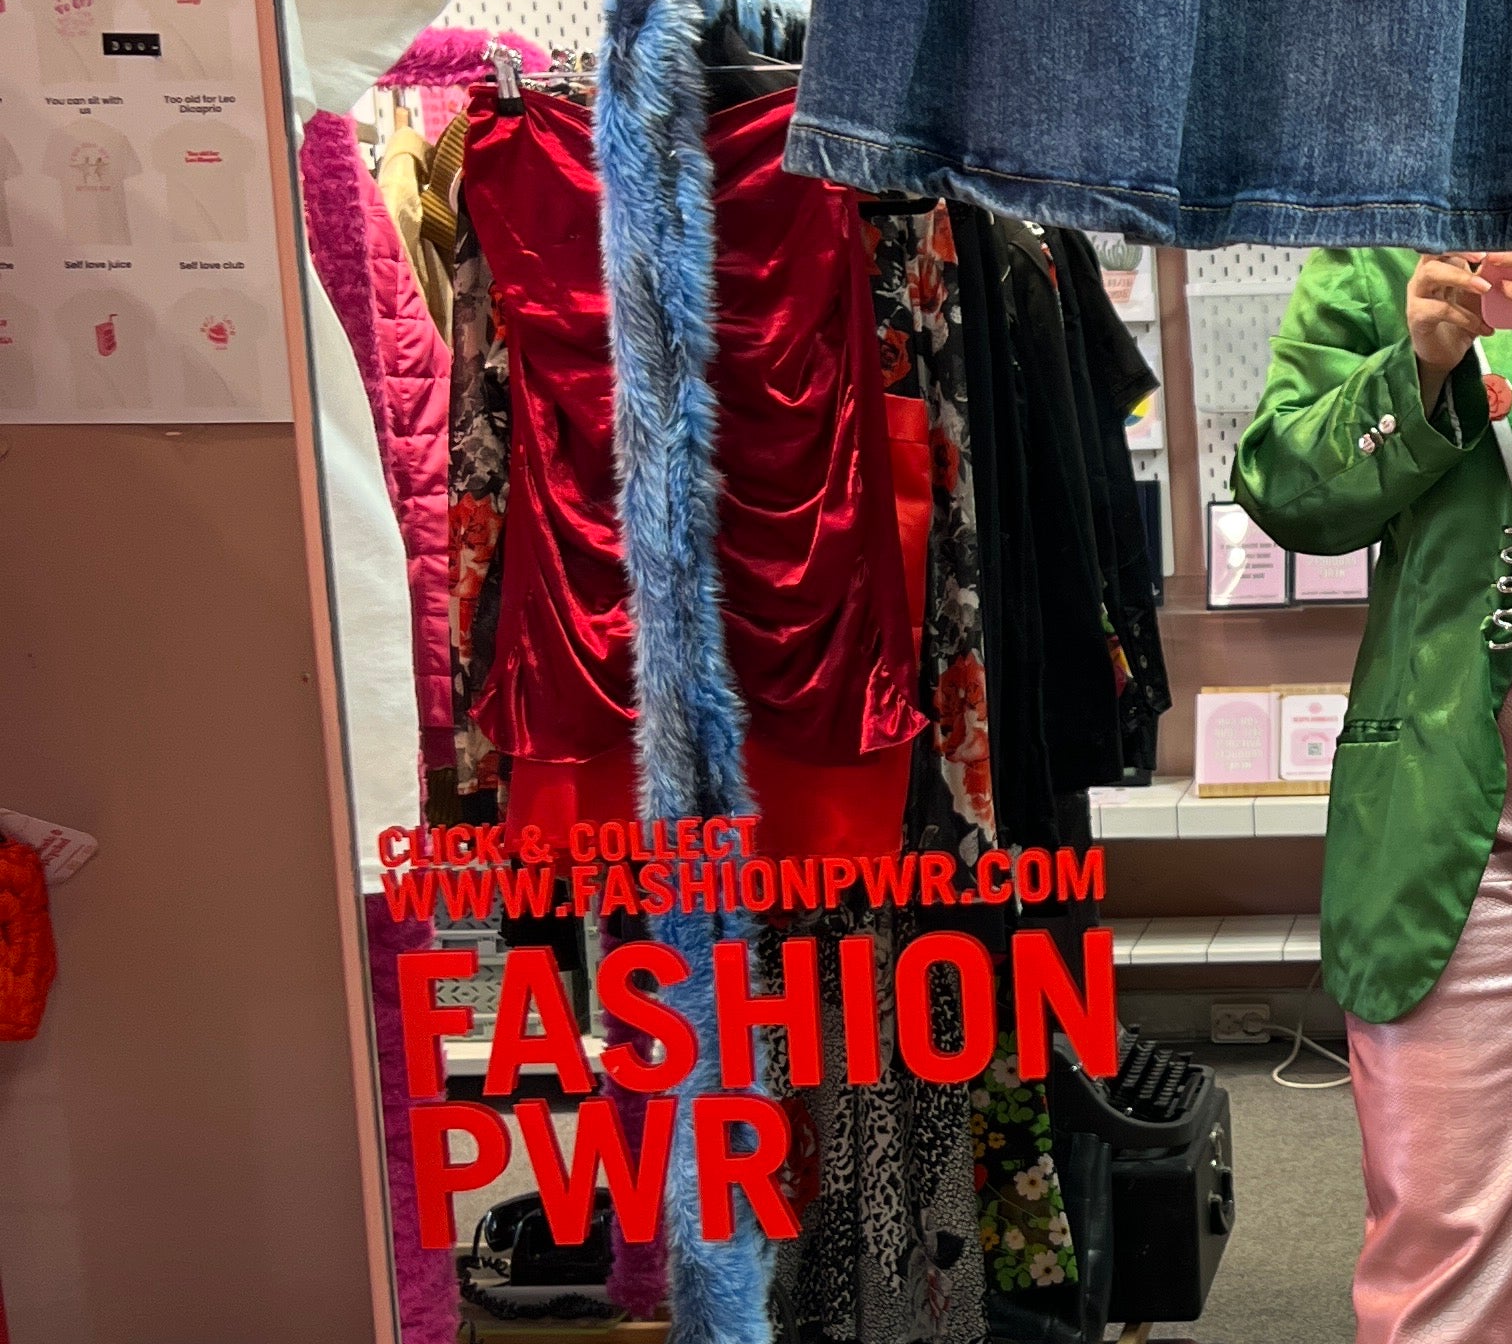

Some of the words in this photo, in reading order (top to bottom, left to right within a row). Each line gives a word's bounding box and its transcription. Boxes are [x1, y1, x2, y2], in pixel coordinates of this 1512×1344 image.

[46, 97, 64, 105] You
[102, 96, 123, 105] with
[64, 260, 83, 269] Self
[85, 261, 106, 269] love
[108, 260, 132, 270] juice
[180, 261, 198, 270] Self
[200, 261, 220, 269] love
[378, 824, 504, 867] CLICK
[520, 825, 552, 863] &
[569, 816, 760, 863] COLLECT
[379, 847, 1106, 922] WWW.FASHIONPWR.COM
[398, 928, 1119, 1099] FASHION
[408, 1094, 801, 1250] PWR
